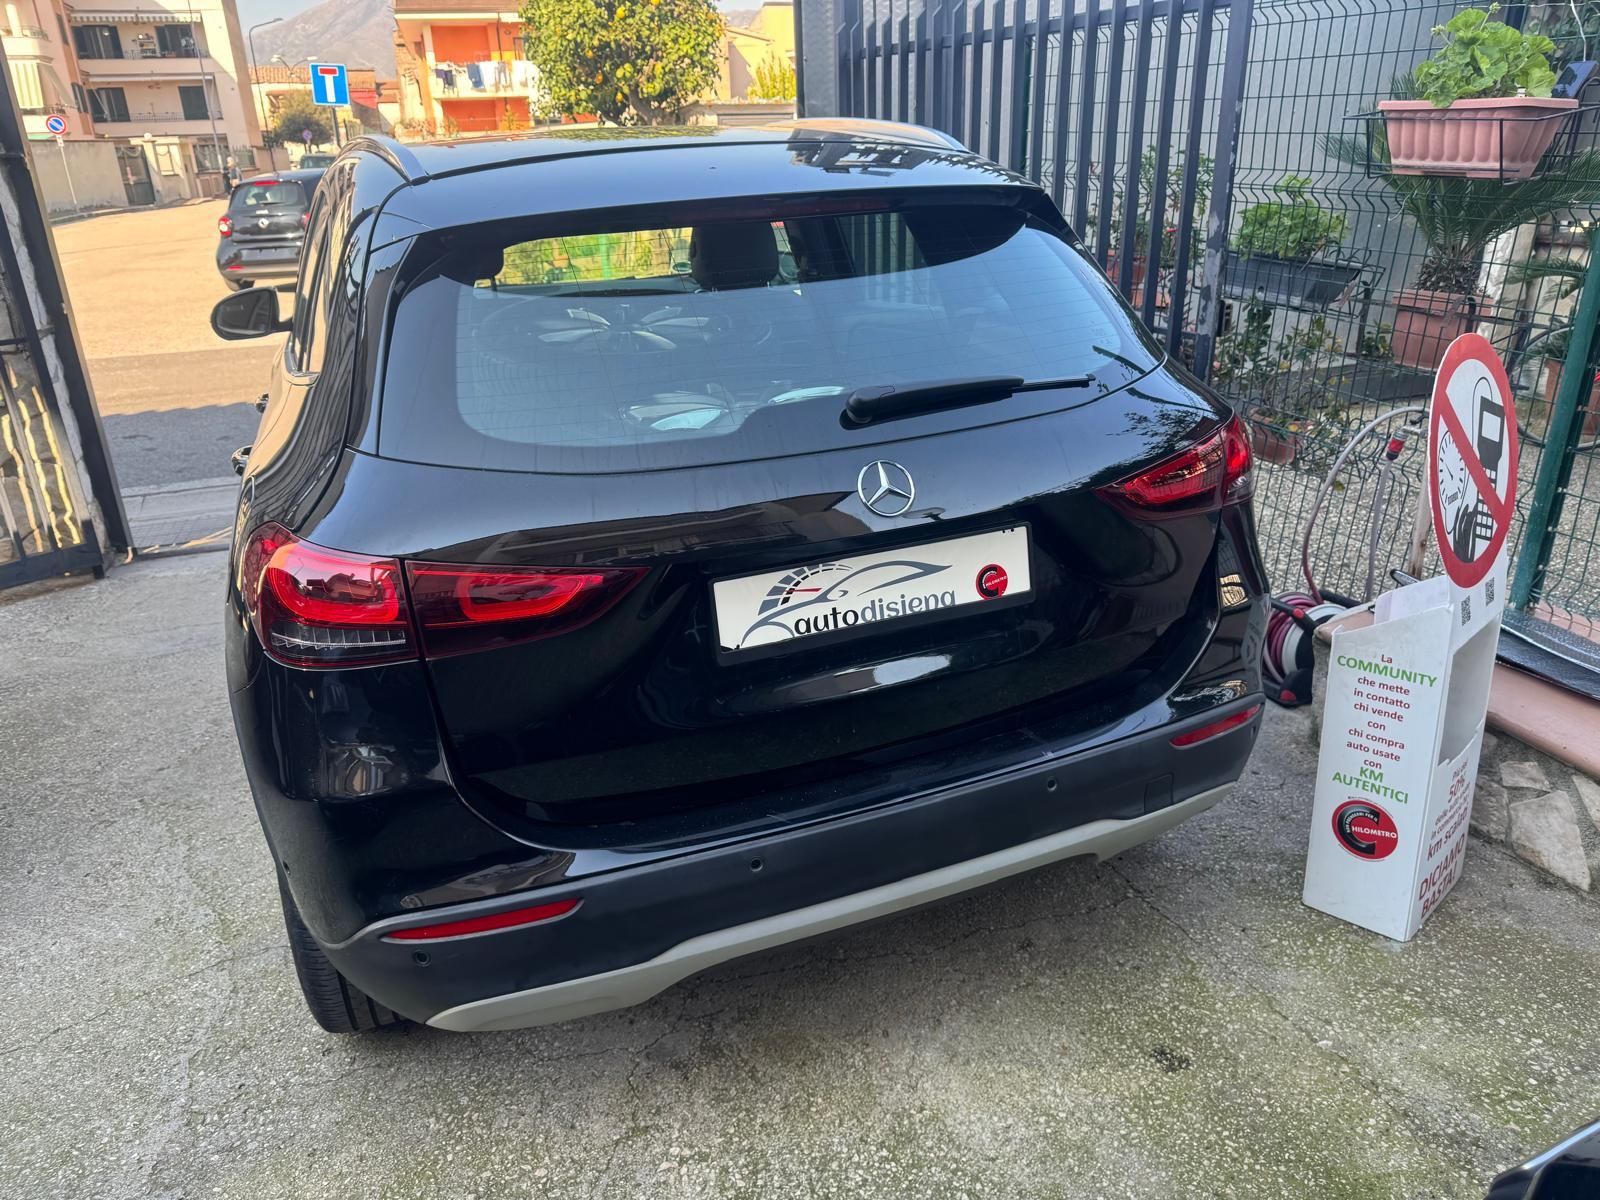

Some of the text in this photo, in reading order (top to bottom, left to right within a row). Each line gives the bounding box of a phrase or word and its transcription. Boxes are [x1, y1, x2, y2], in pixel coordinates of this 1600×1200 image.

[794, 589, 957, 635] autodisiena
[1381, 654, 1393, 664] La
[1337, 655, 1438, 687] COMMUNITY
[1357, 676, 1411, 696] che mette
[1353, 687, 1411, 710] in contatto
[1353, 702, 1404, 722] chi vende
[1367, 720, 1386, 731] con
[1348, 727, 1405, 750] chi compra
[1346, 740, 1401, 762] auto usate
[1360, 766, 1384, 783] KM
[1363, 758, 1382, 770] con
[1332, 771, 1409, 804] AUTENTICI
[1427, 838, 1442, 861] km
[1419, 832, 1465, 900] DICIAMO
[1421, 860, 1457, 919] BASTA!
